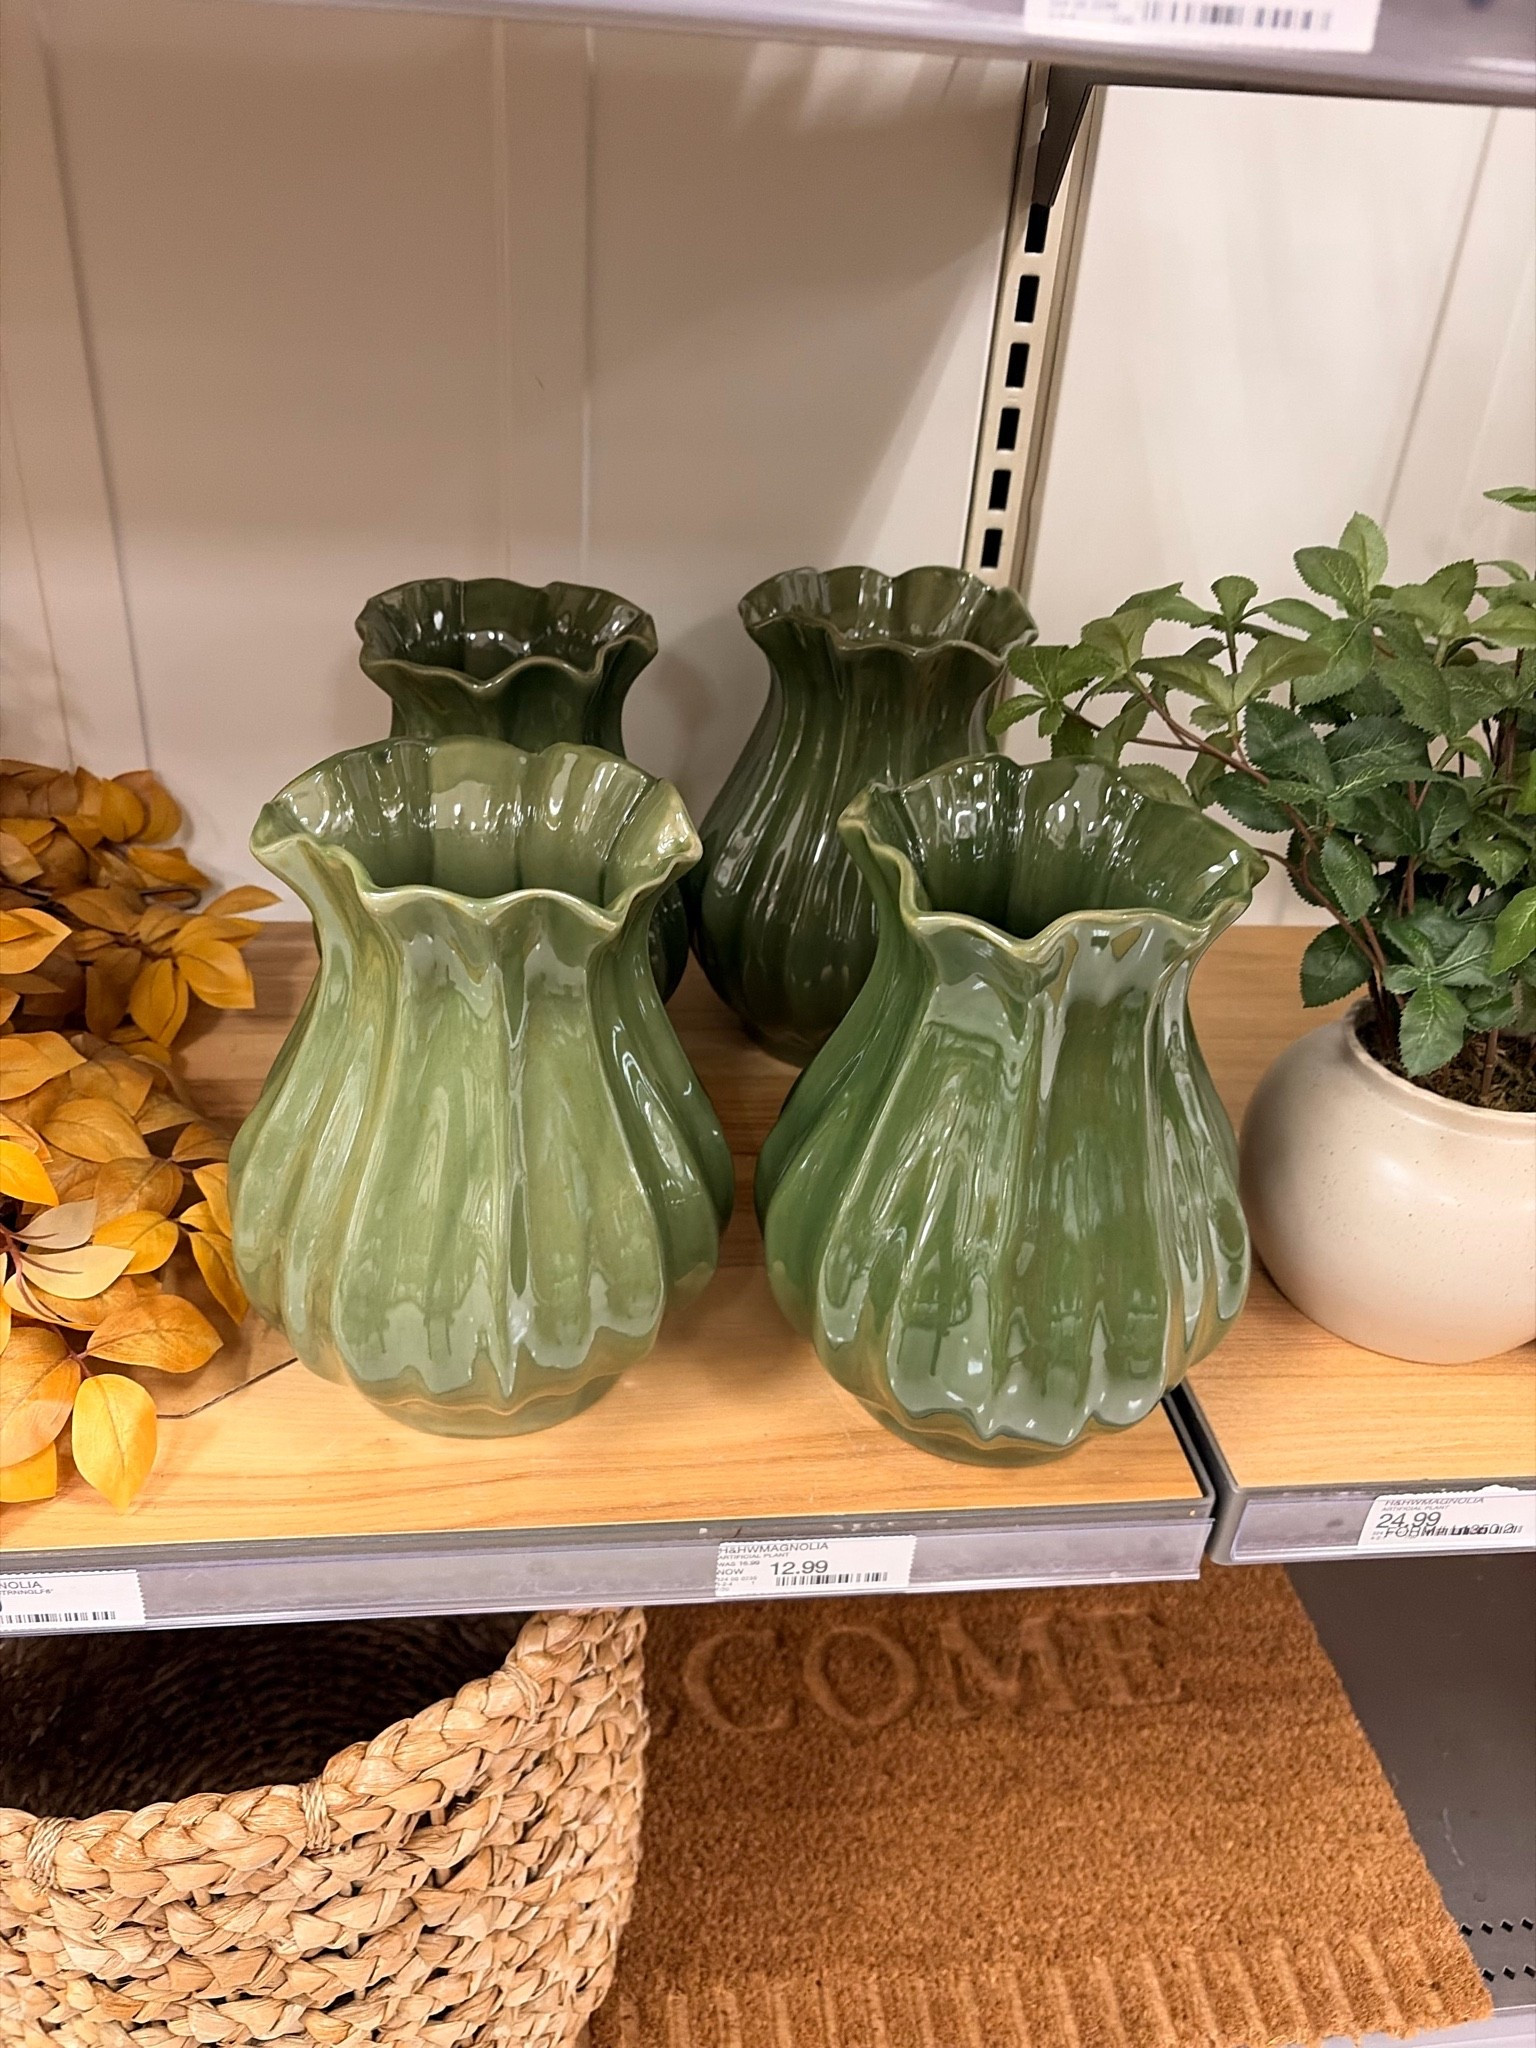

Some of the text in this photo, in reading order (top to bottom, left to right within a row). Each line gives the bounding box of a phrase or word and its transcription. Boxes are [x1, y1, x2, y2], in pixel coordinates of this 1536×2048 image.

[1376, 1511, 1442, 1529] 24.99
[715, 1568, 745, 1576] NOW
[770, 1560, 829, 1575] 12.99
[0, 1581, 43, 1590] NOLIA
[650, 1609, 1188, 1739] COME
